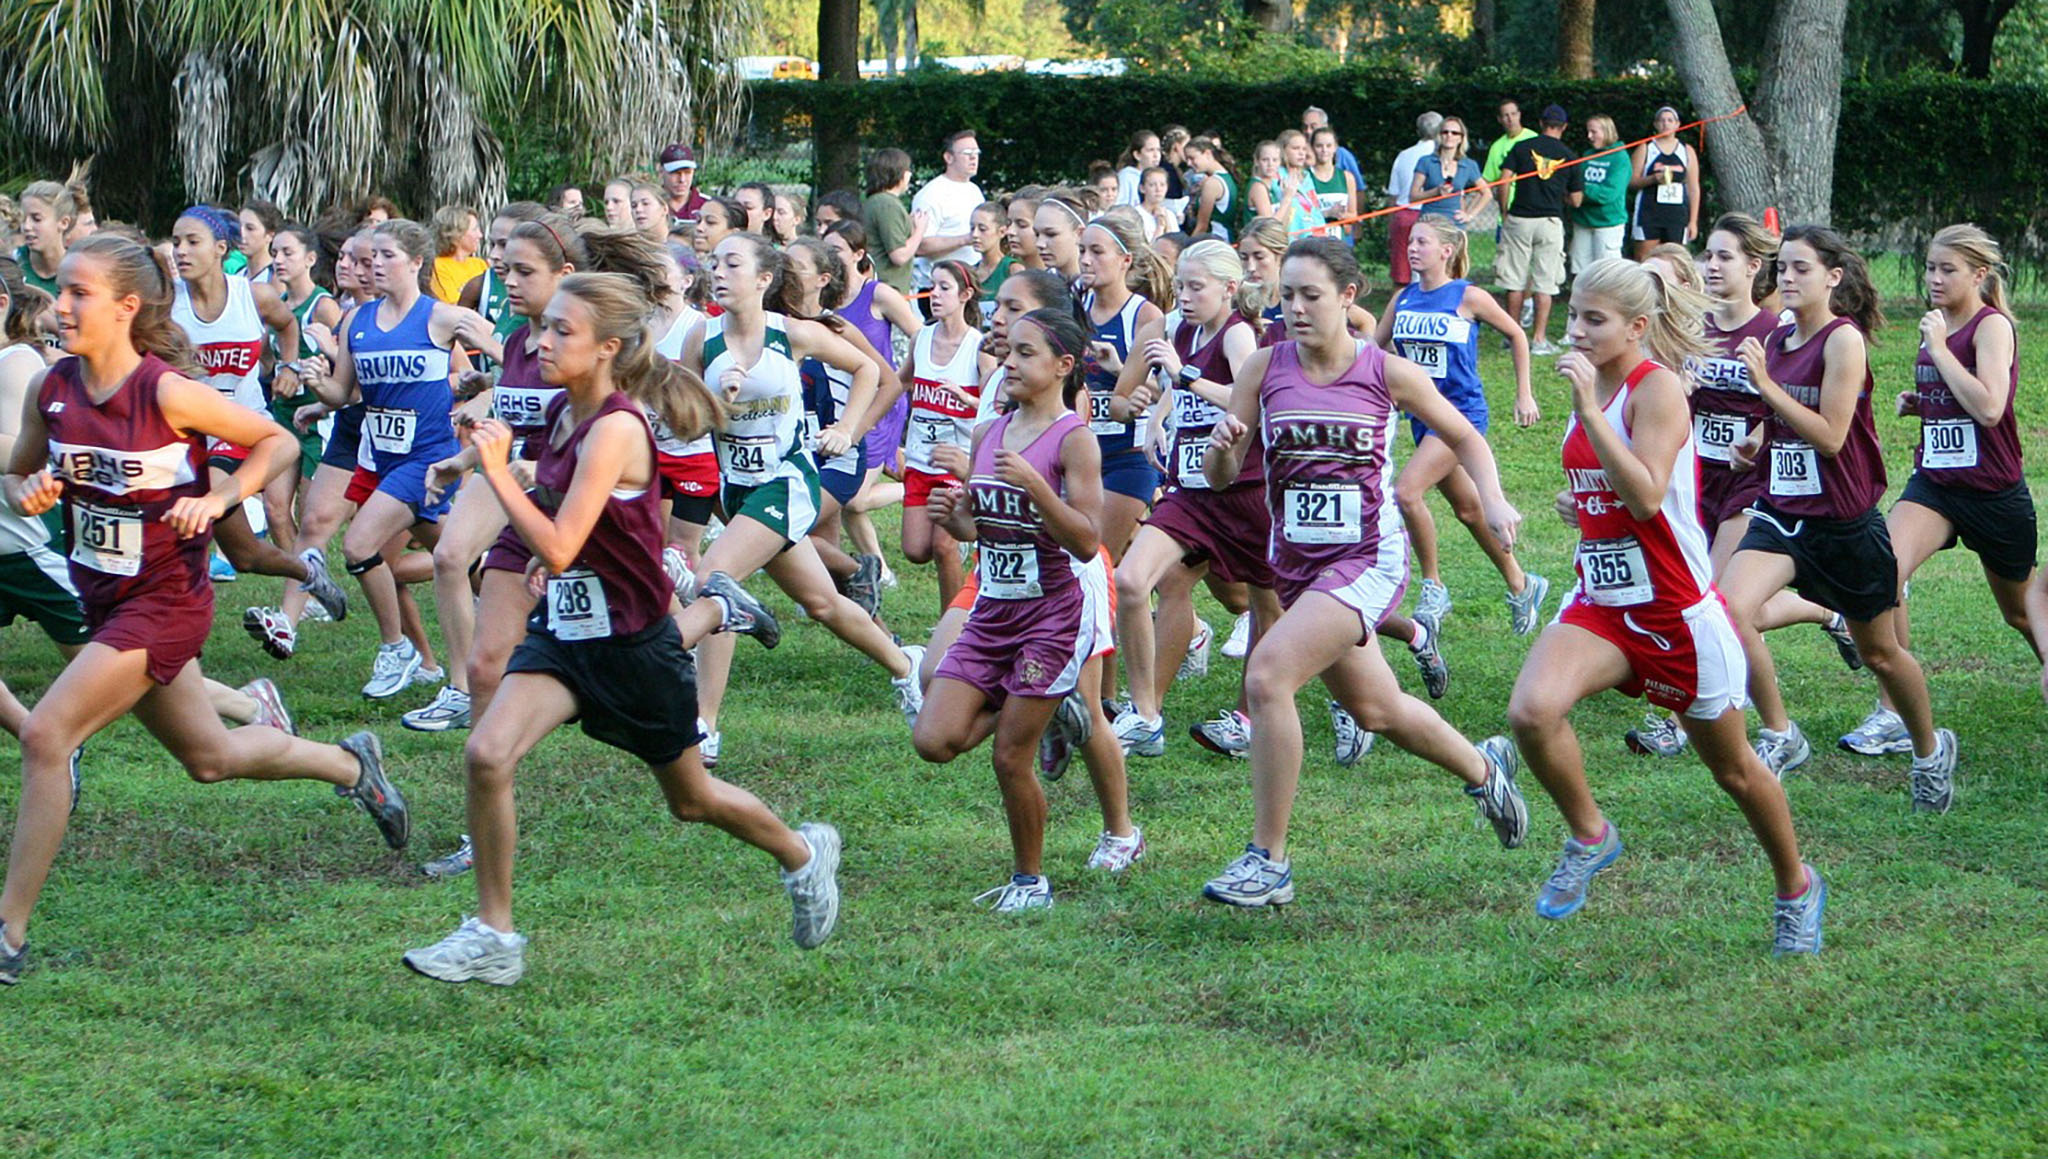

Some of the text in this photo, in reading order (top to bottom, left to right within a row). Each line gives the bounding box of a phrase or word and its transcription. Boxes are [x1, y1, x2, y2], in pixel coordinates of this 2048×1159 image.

[375, 415, 405, 436] 176
[1702, 418, 1734, 443] 255
[1931, 426, 1964, 449] 300
[728, 444, 765, 468] 234
[1185, 446, 1209, 469] 25
[1777, 452, 1807, 476] 303
[1296, 492, 1341, 521] 321
[81, 511, 119, 549] 251
[987, 550, 1026, 578] 322
[1588, 552, 1632, 584] 355
[555, 580, 591, 614] 298
